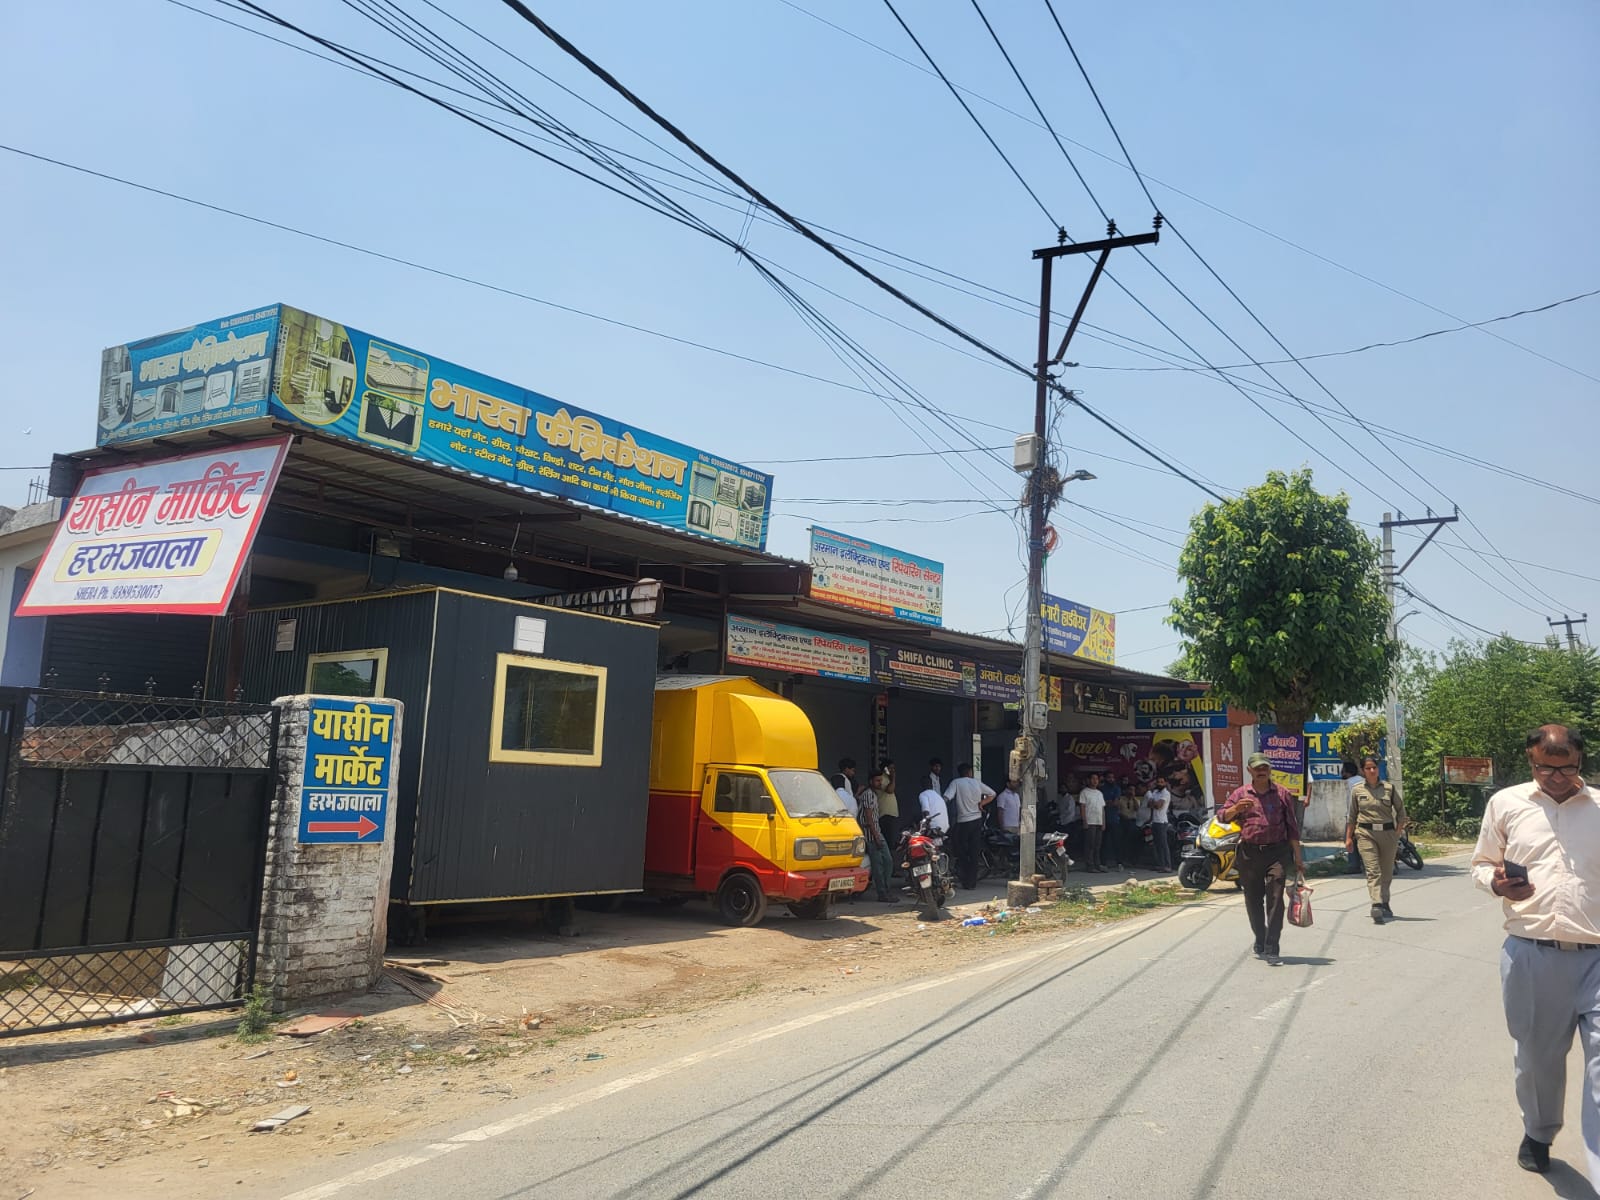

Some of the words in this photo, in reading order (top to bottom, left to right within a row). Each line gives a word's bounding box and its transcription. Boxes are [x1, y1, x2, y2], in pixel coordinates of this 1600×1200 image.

[430, 378, 532, 437] भारत
[428, 418, 452, 434] हमारे
[66, 477, 161, 535] यासीन
[68, 536, 208, 577] हरभजवाला
[814, 542, 839, 556] अरमान
[898, 650, 924, 666] SHIFA
[926, 654, 954, 670] CLINIC
[1138, 694, 1181, 713] यासीन
[312, 704, 392, 742] यासीन
[1151, 717, 1210, 728] हरभजवाला
[1064, 736, 1112, 760] Lazer
[314, 746, 384, 786] मार्केट
[308, 792, 383, 812] हरभजवाला
